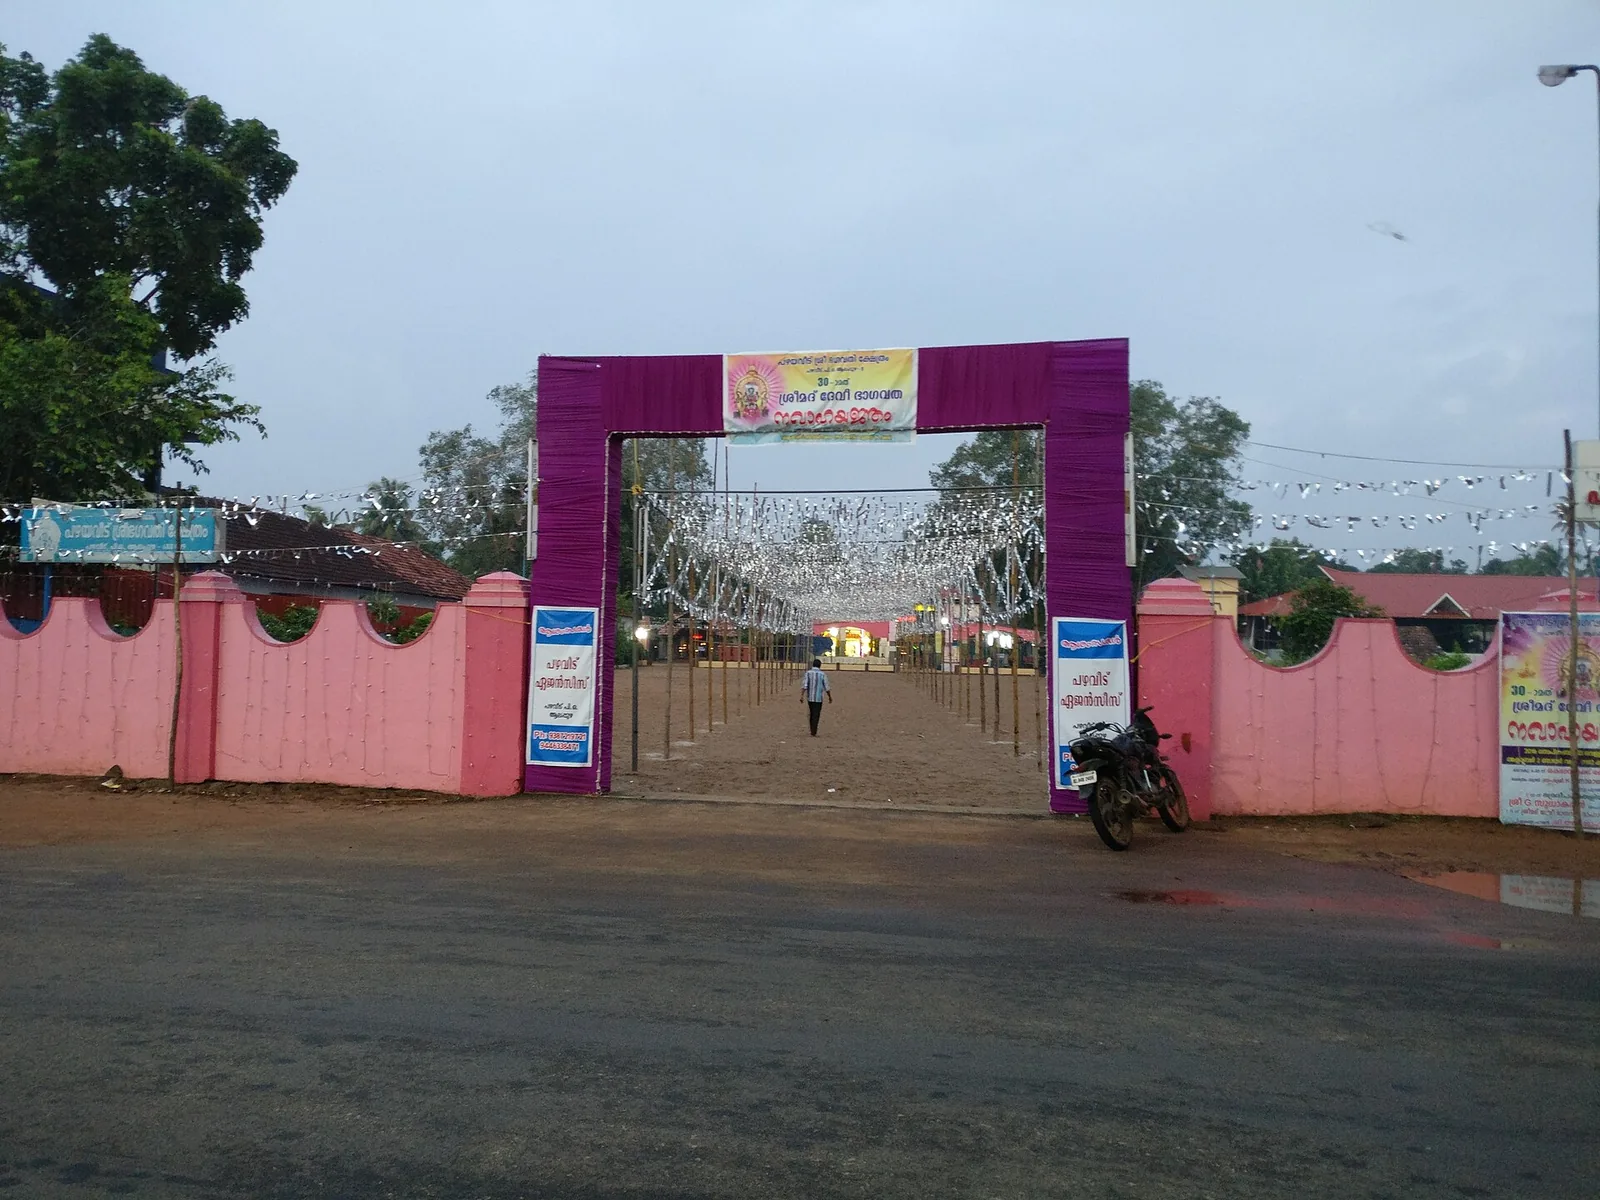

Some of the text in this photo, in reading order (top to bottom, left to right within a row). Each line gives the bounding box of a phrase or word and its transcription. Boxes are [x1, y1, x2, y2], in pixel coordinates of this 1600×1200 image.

[778, 389, 818, 406] ശ്രീമദ്
[854, 389, 903, 401] ഭാഗവത
[1512, 699, 1556, 713] ശ്രീമദ്
